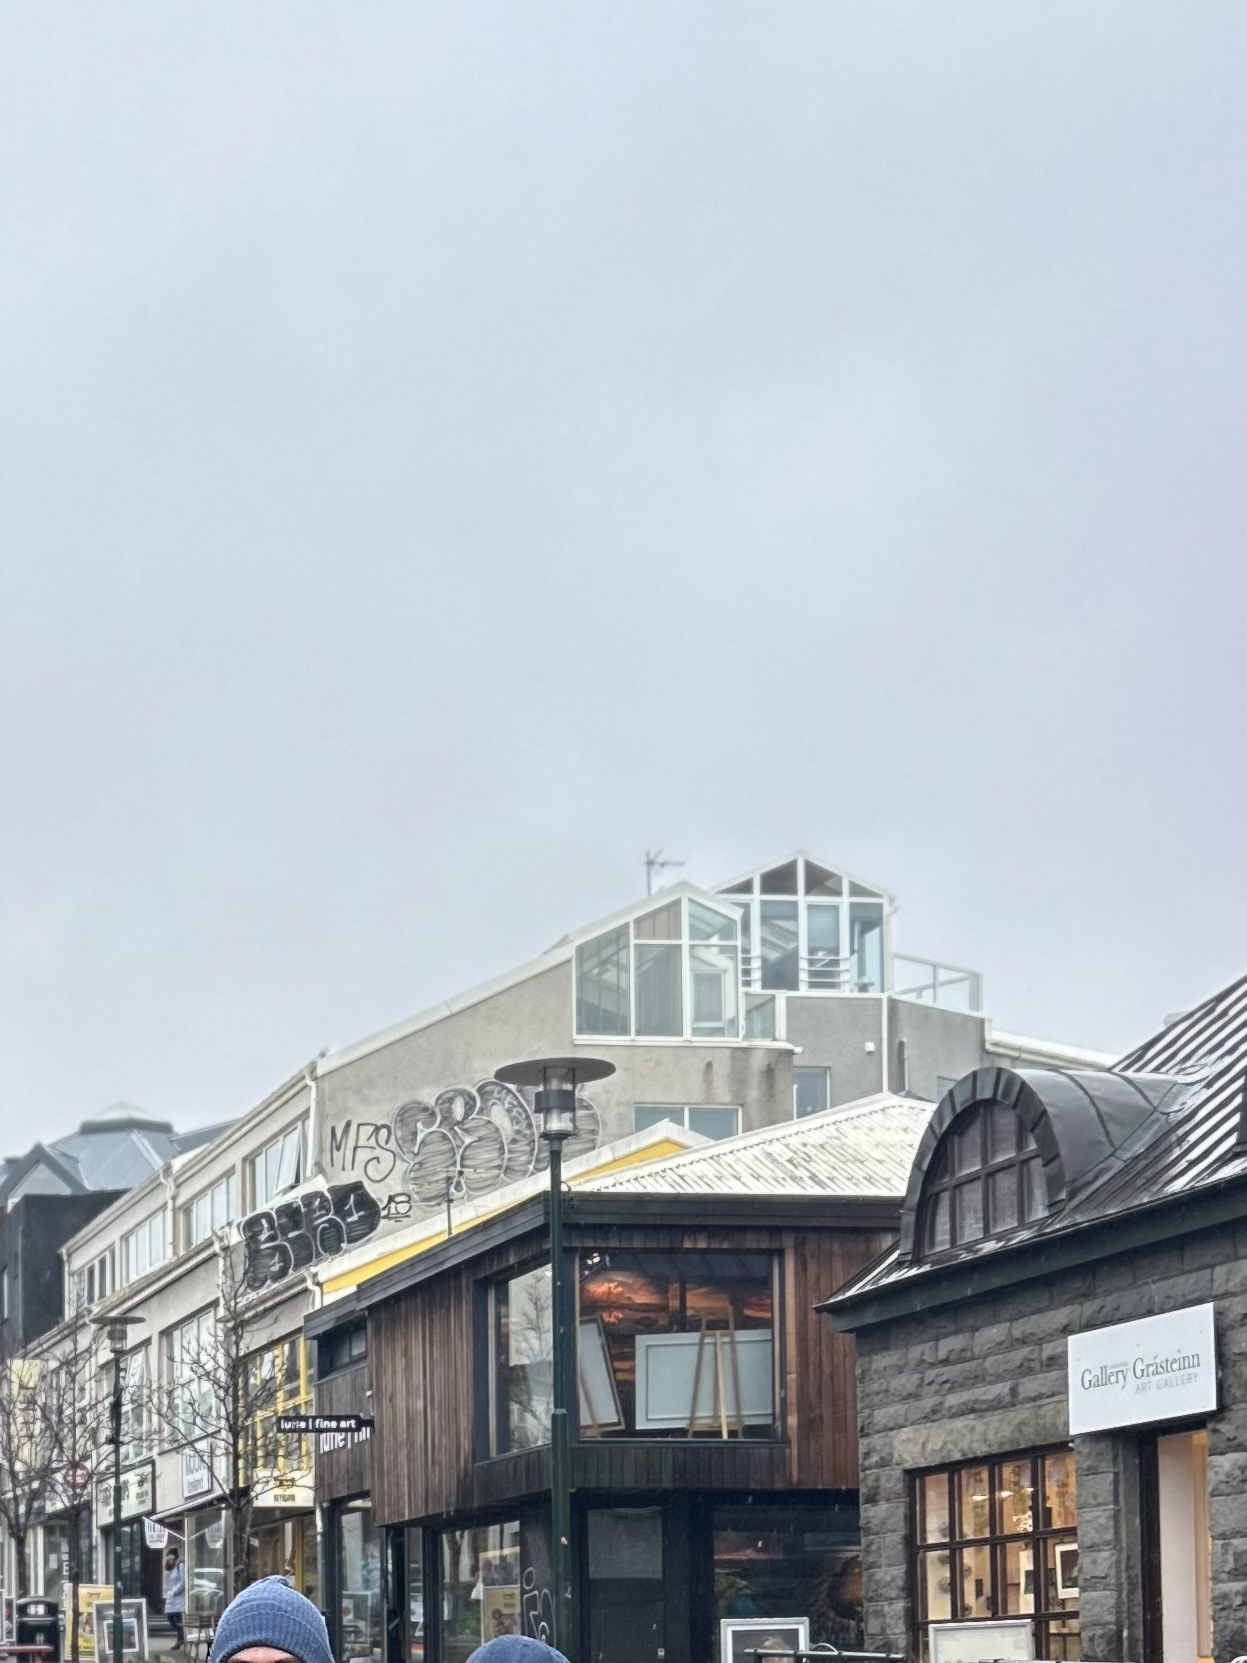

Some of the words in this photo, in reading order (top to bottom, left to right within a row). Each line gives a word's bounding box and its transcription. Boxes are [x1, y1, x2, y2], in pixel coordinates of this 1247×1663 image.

[1081, 1366, 1128, 1390] Gallery
[1133, 1350, 1200, 1380] Grásteinn
[1135, 1381, 1152, 1395] ART
[1156, 1373, 1199, 1391] GALLERY
[315, 1418, 337, 1429] fine
[339, 1419, 356, 1429] art
